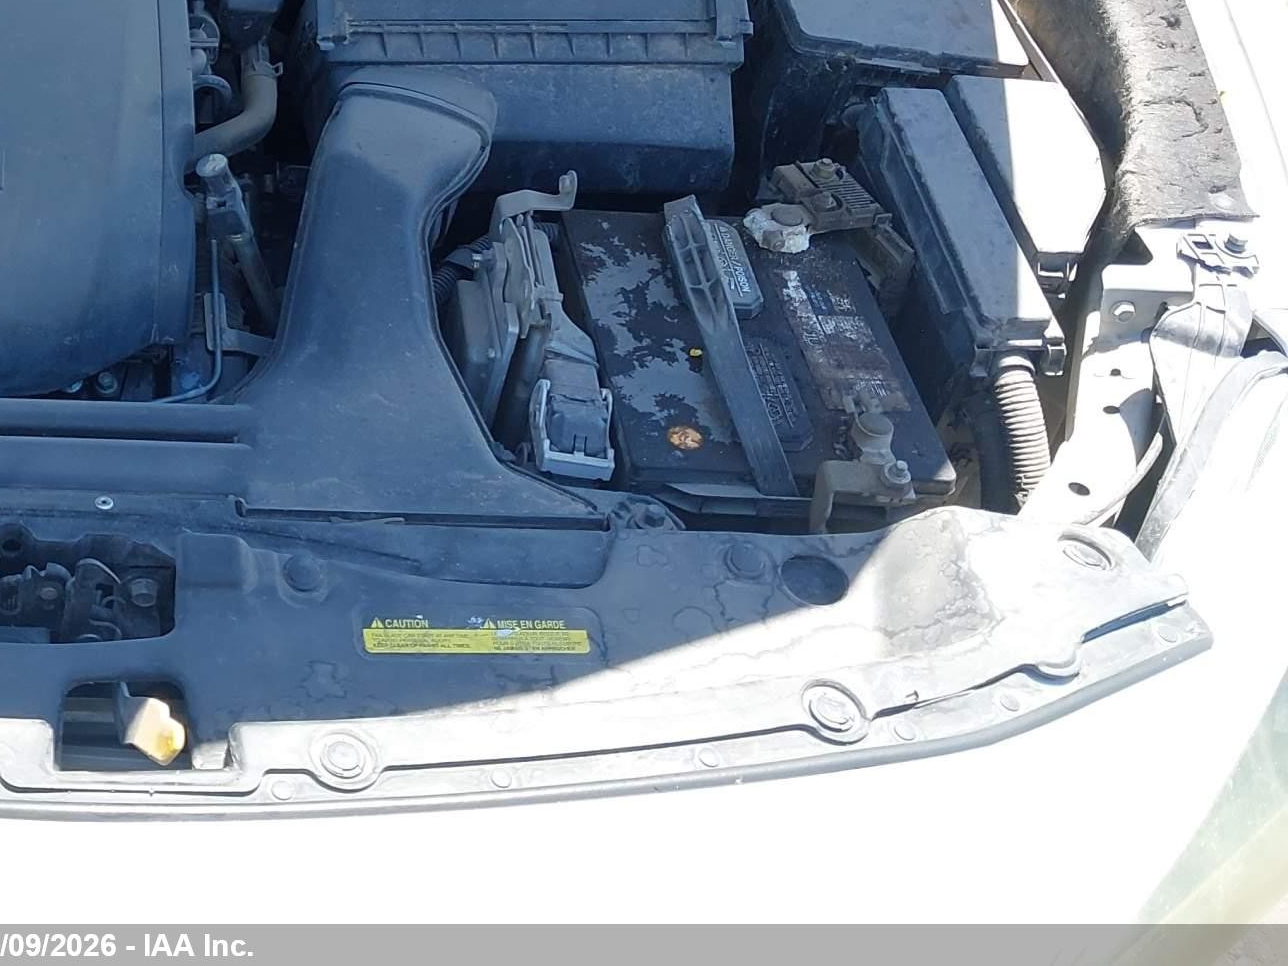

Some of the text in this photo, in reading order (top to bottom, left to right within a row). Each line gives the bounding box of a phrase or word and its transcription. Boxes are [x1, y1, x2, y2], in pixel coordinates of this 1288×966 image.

[385, 619, 429, 629] CAUTION
[497, 619, 566, 629] MISE EN GARDE
